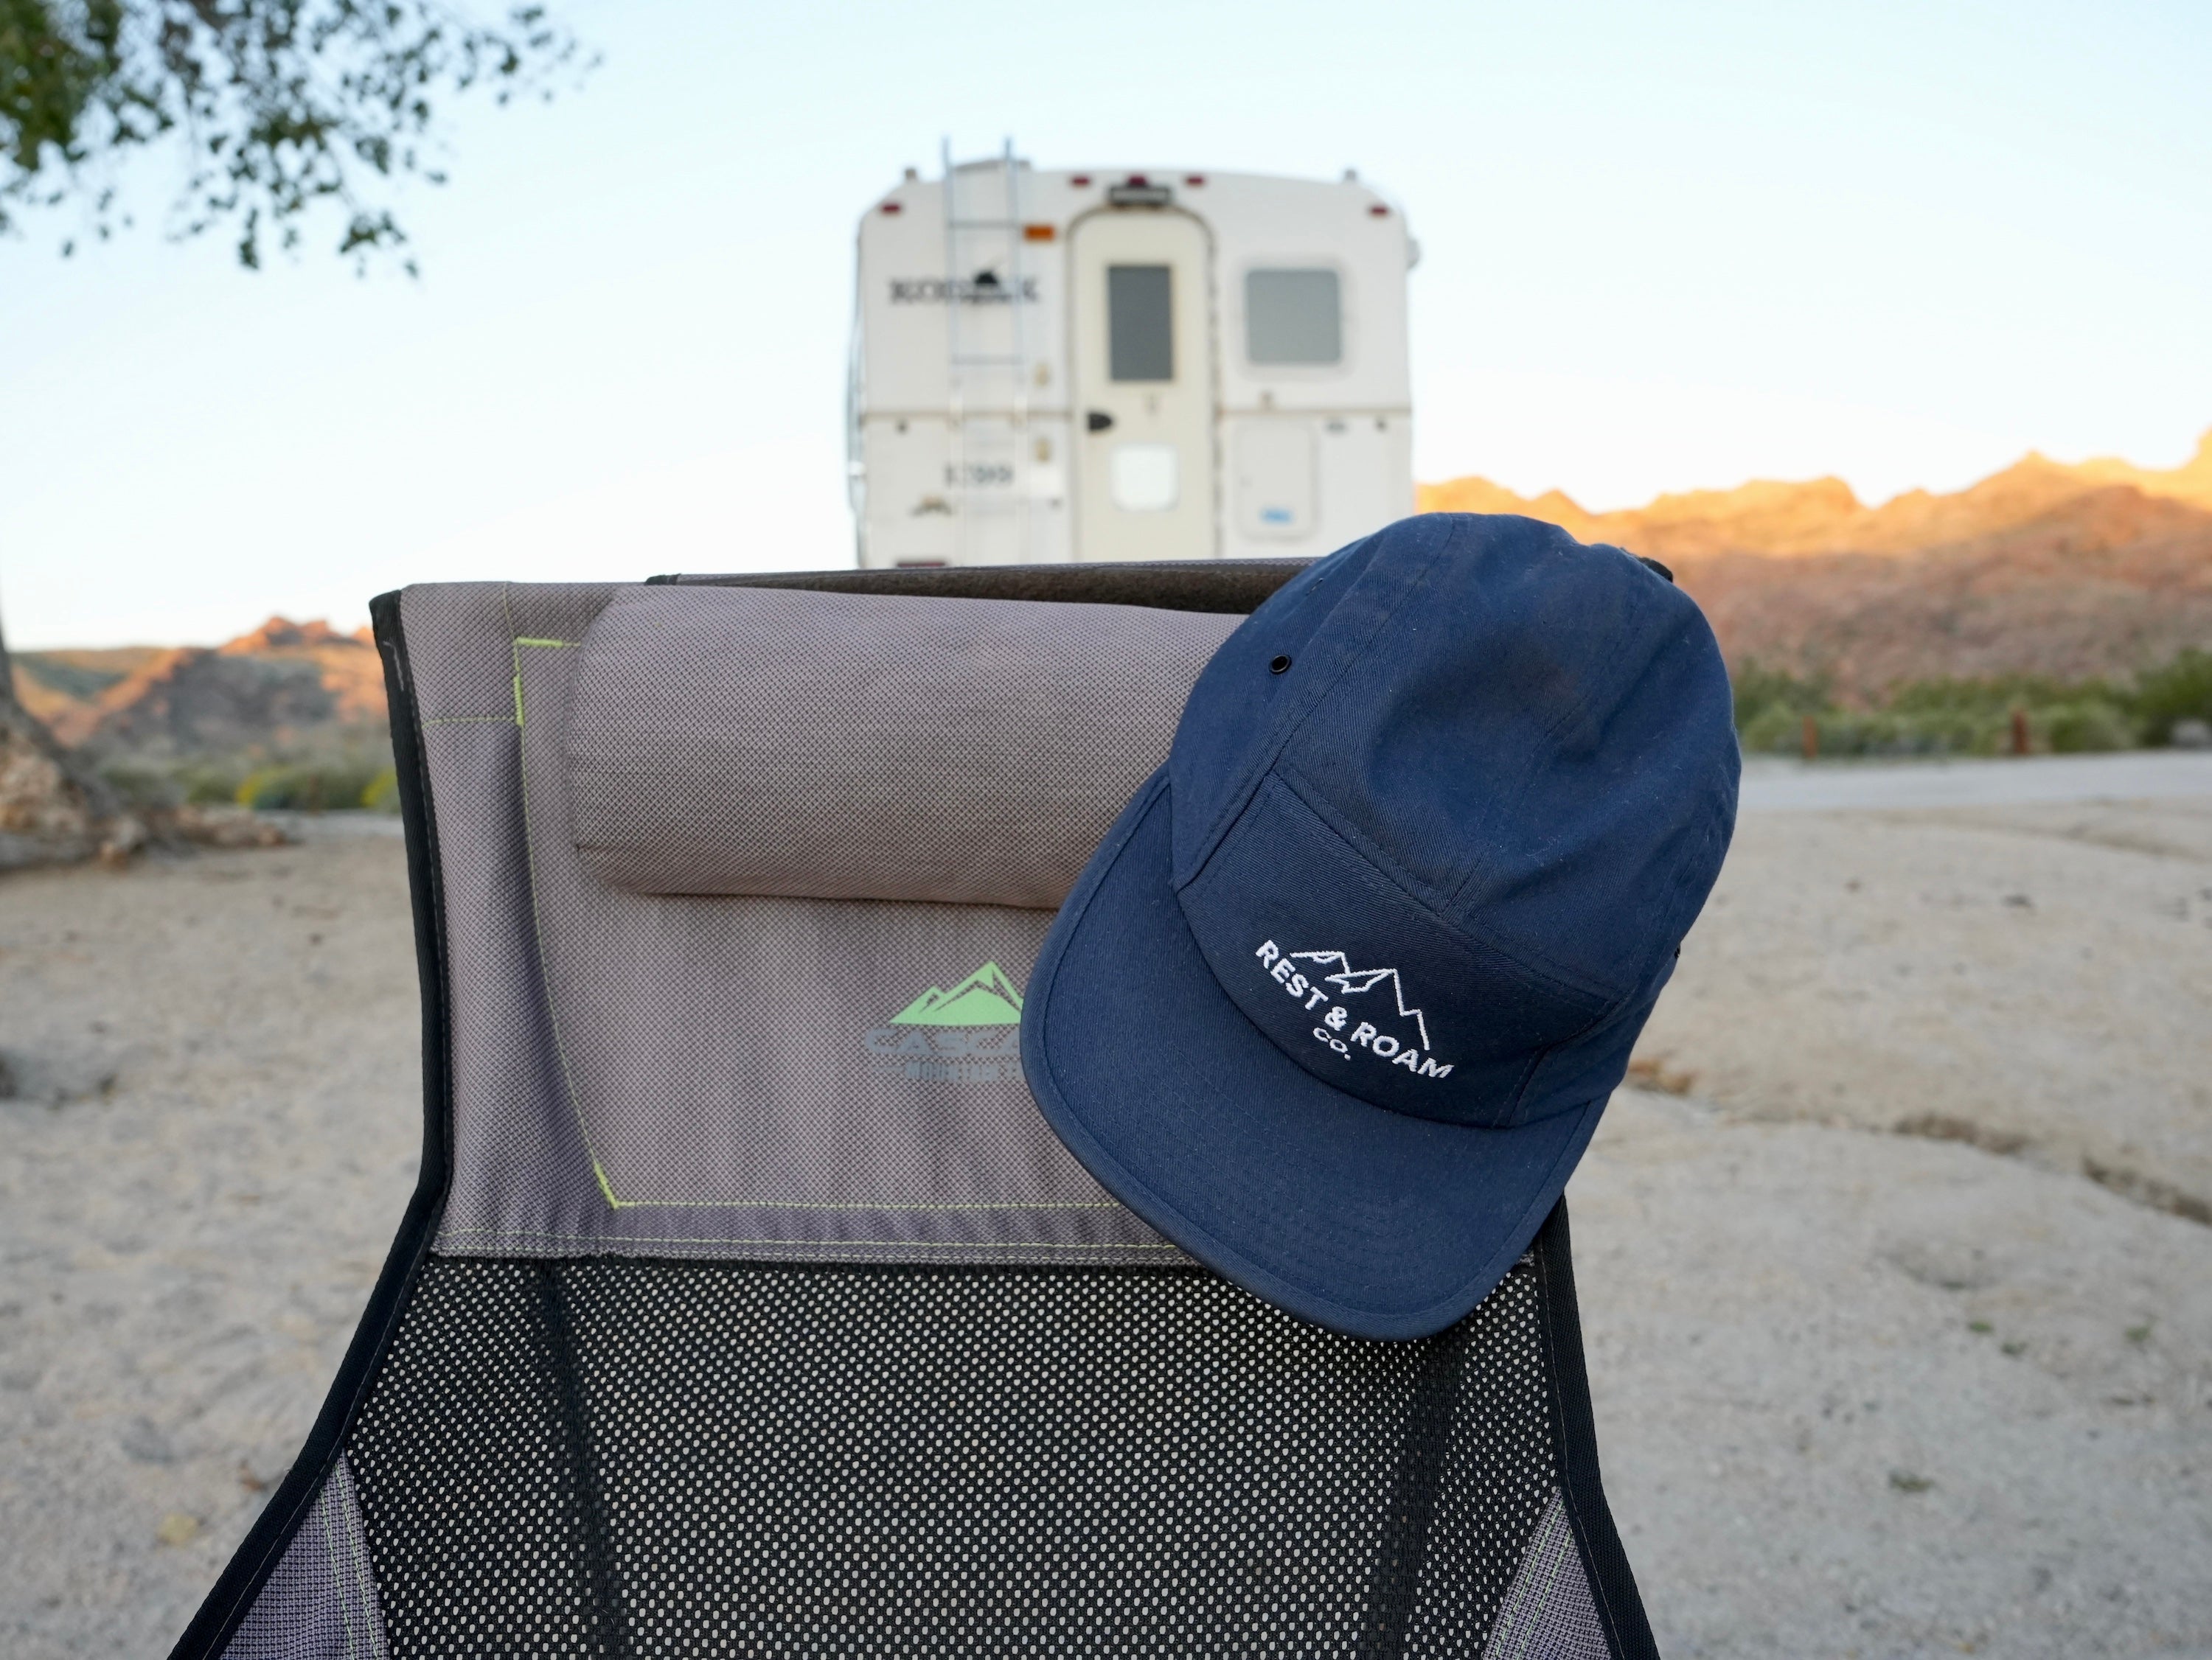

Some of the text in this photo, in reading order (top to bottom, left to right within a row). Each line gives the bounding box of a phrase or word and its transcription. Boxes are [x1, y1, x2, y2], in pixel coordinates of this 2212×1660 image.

[1256, 939, 1455, 1078] REST & ROAM
[1312, 1027, 1352, 1061] CO.
